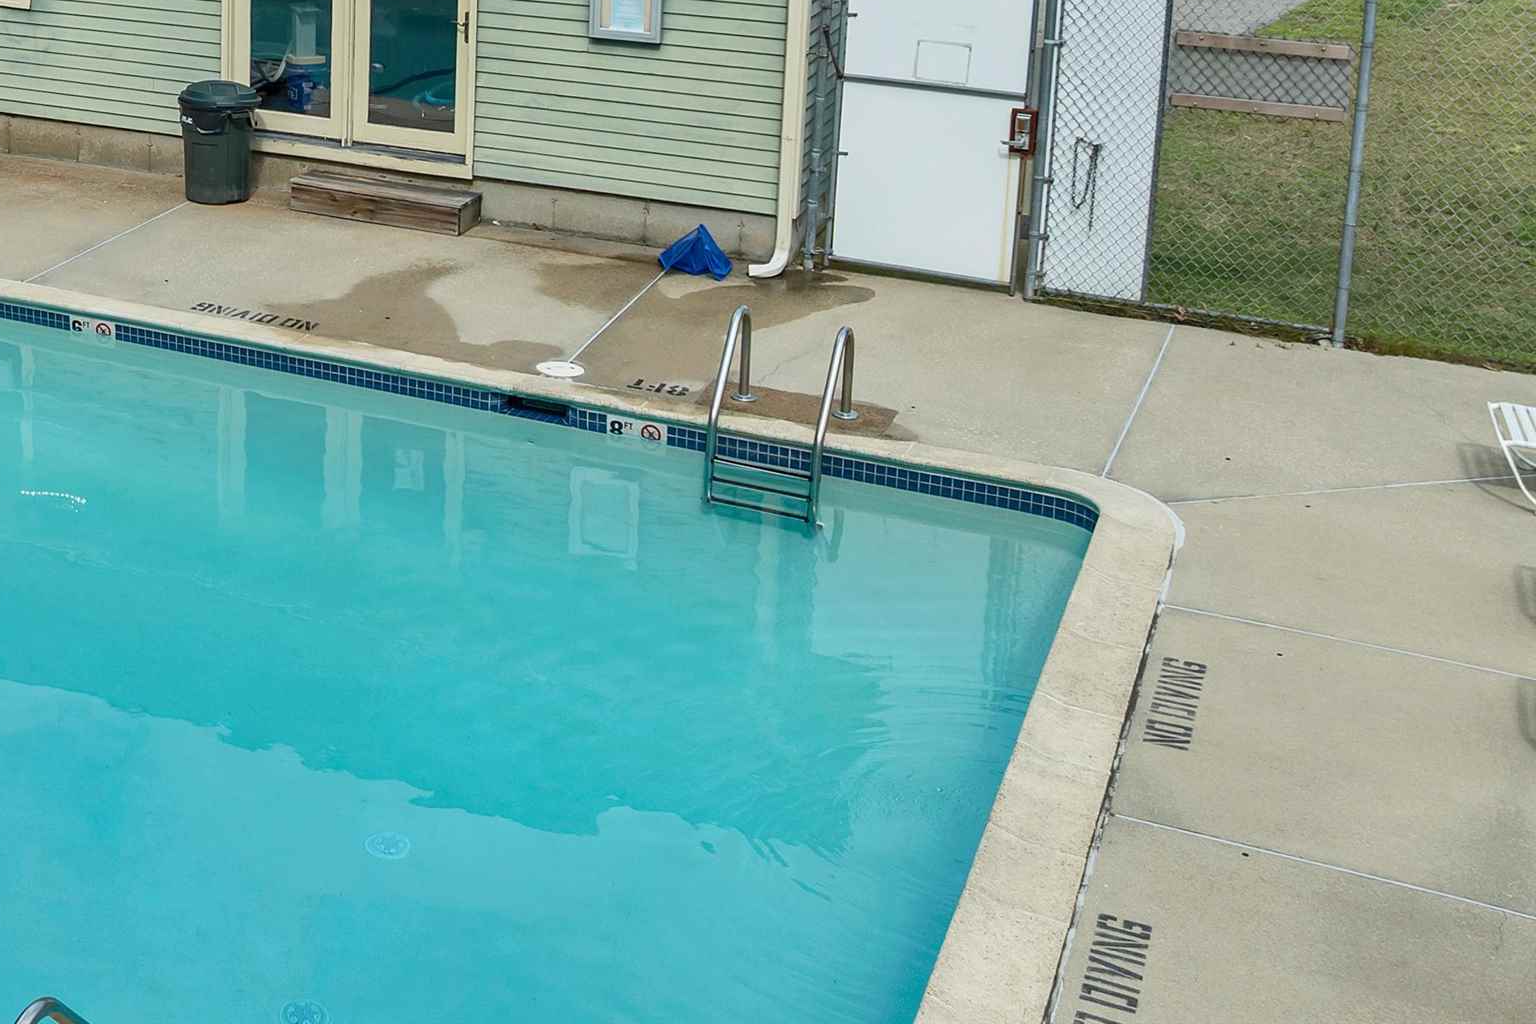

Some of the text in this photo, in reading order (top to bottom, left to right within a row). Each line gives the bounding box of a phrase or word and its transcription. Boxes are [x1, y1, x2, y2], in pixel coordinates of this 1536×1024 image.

[190, 302, 321, 331] NO DIVING
[1143, 657, 1207, 751] NO DIVING
[1078, 913, 1153, 1014] DIVING
